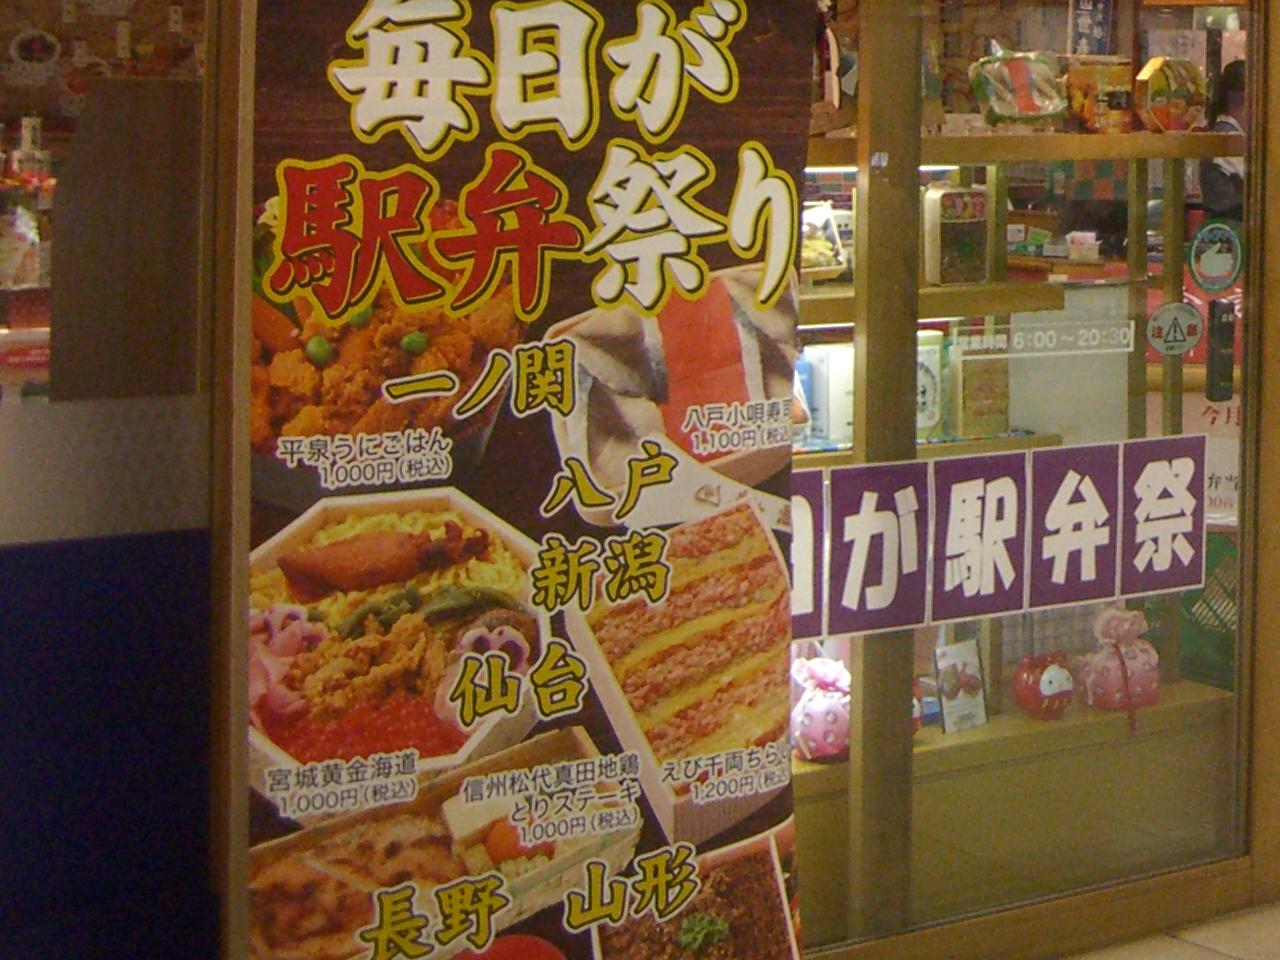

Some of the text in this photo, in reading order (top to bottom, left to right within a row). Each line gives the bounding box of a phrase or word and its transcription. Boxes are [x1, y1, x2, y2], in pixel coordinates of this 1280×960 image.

[268, 146, 796, 321] 駅弁祭り
[383, 341, 576, 417] 一ノ関
[279, 430, 448, 463] 平泉うにごはん
[545, 442, 678, 520] 八戸
[532, 530, 669, 611] 新潟
[791, 456, 1197, 612] が駅弁祭
[449, 642, 587, 725] 仙台
[511, 785, 639, 823] とりステーキ
[359, 874, 510, 960] 長野
[566, 846, 698, 929] 山形
